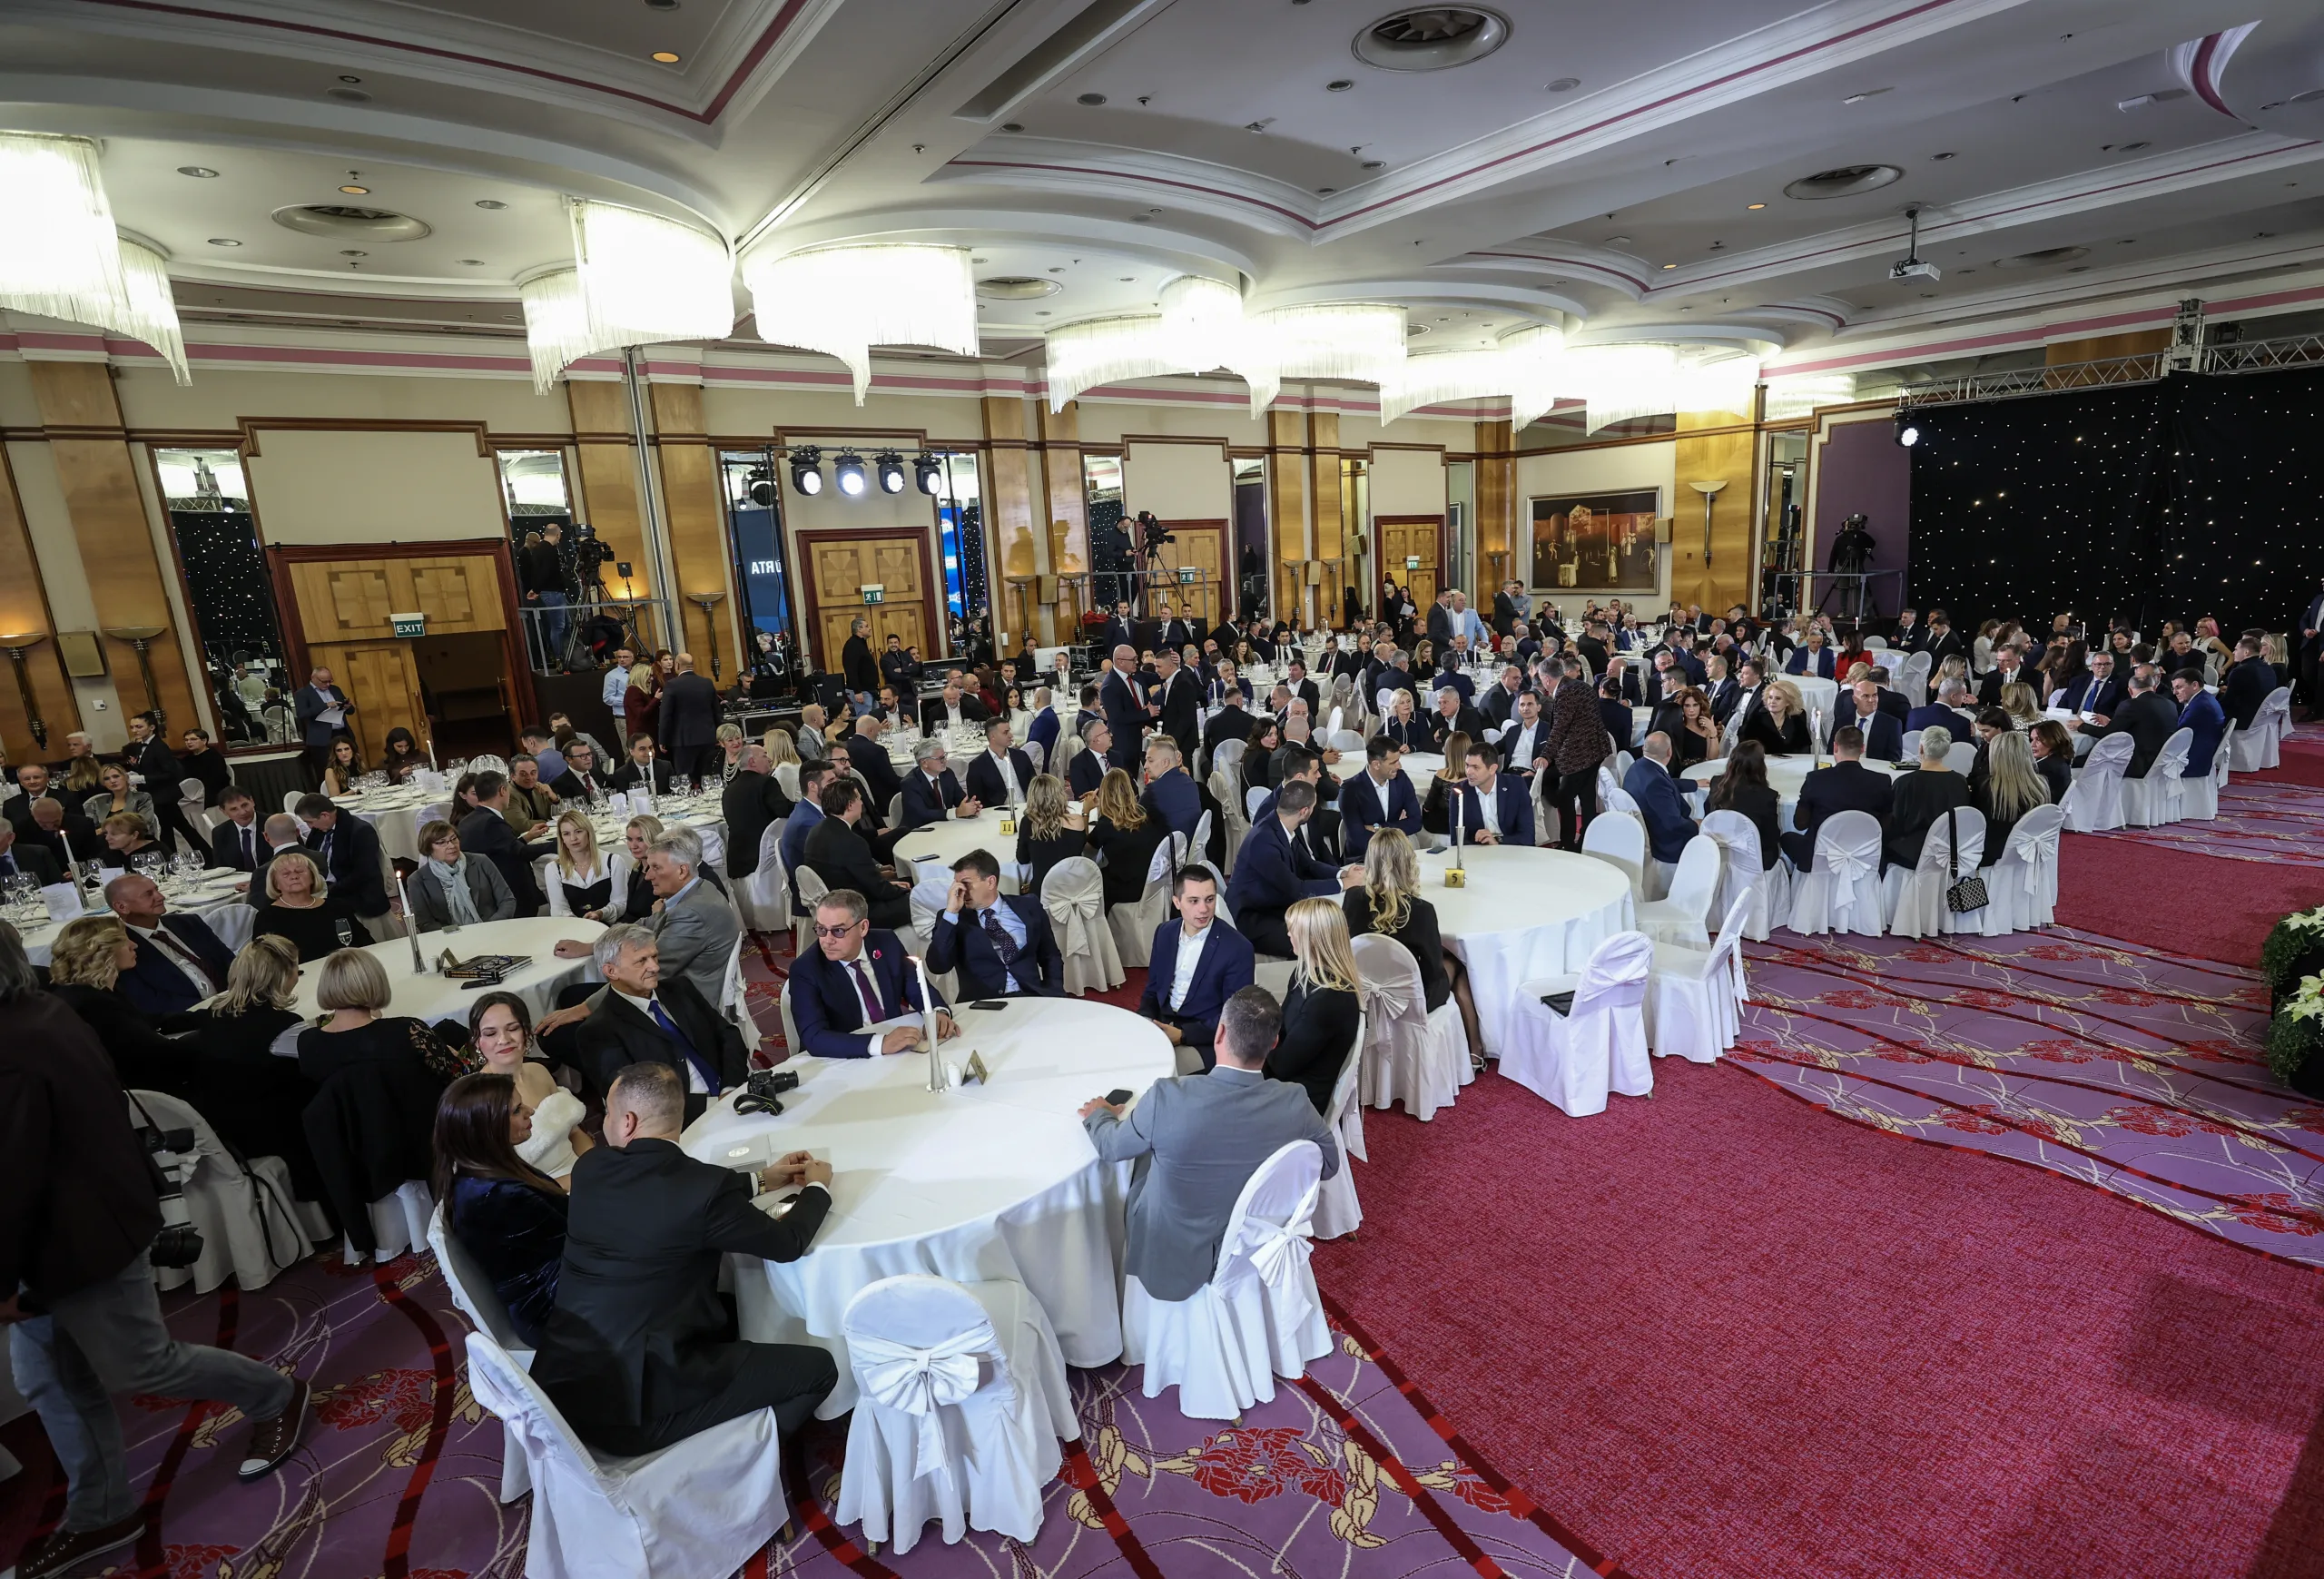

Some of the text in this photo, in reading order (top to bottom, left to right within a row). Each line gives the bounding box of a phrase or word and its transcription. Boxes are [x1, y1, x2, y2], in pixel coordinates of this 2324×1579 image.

[396, 624, 421, 633] EXIT
[1002, 824, 1011, 832] 11
[1452, 873, 1458, 883] 5
